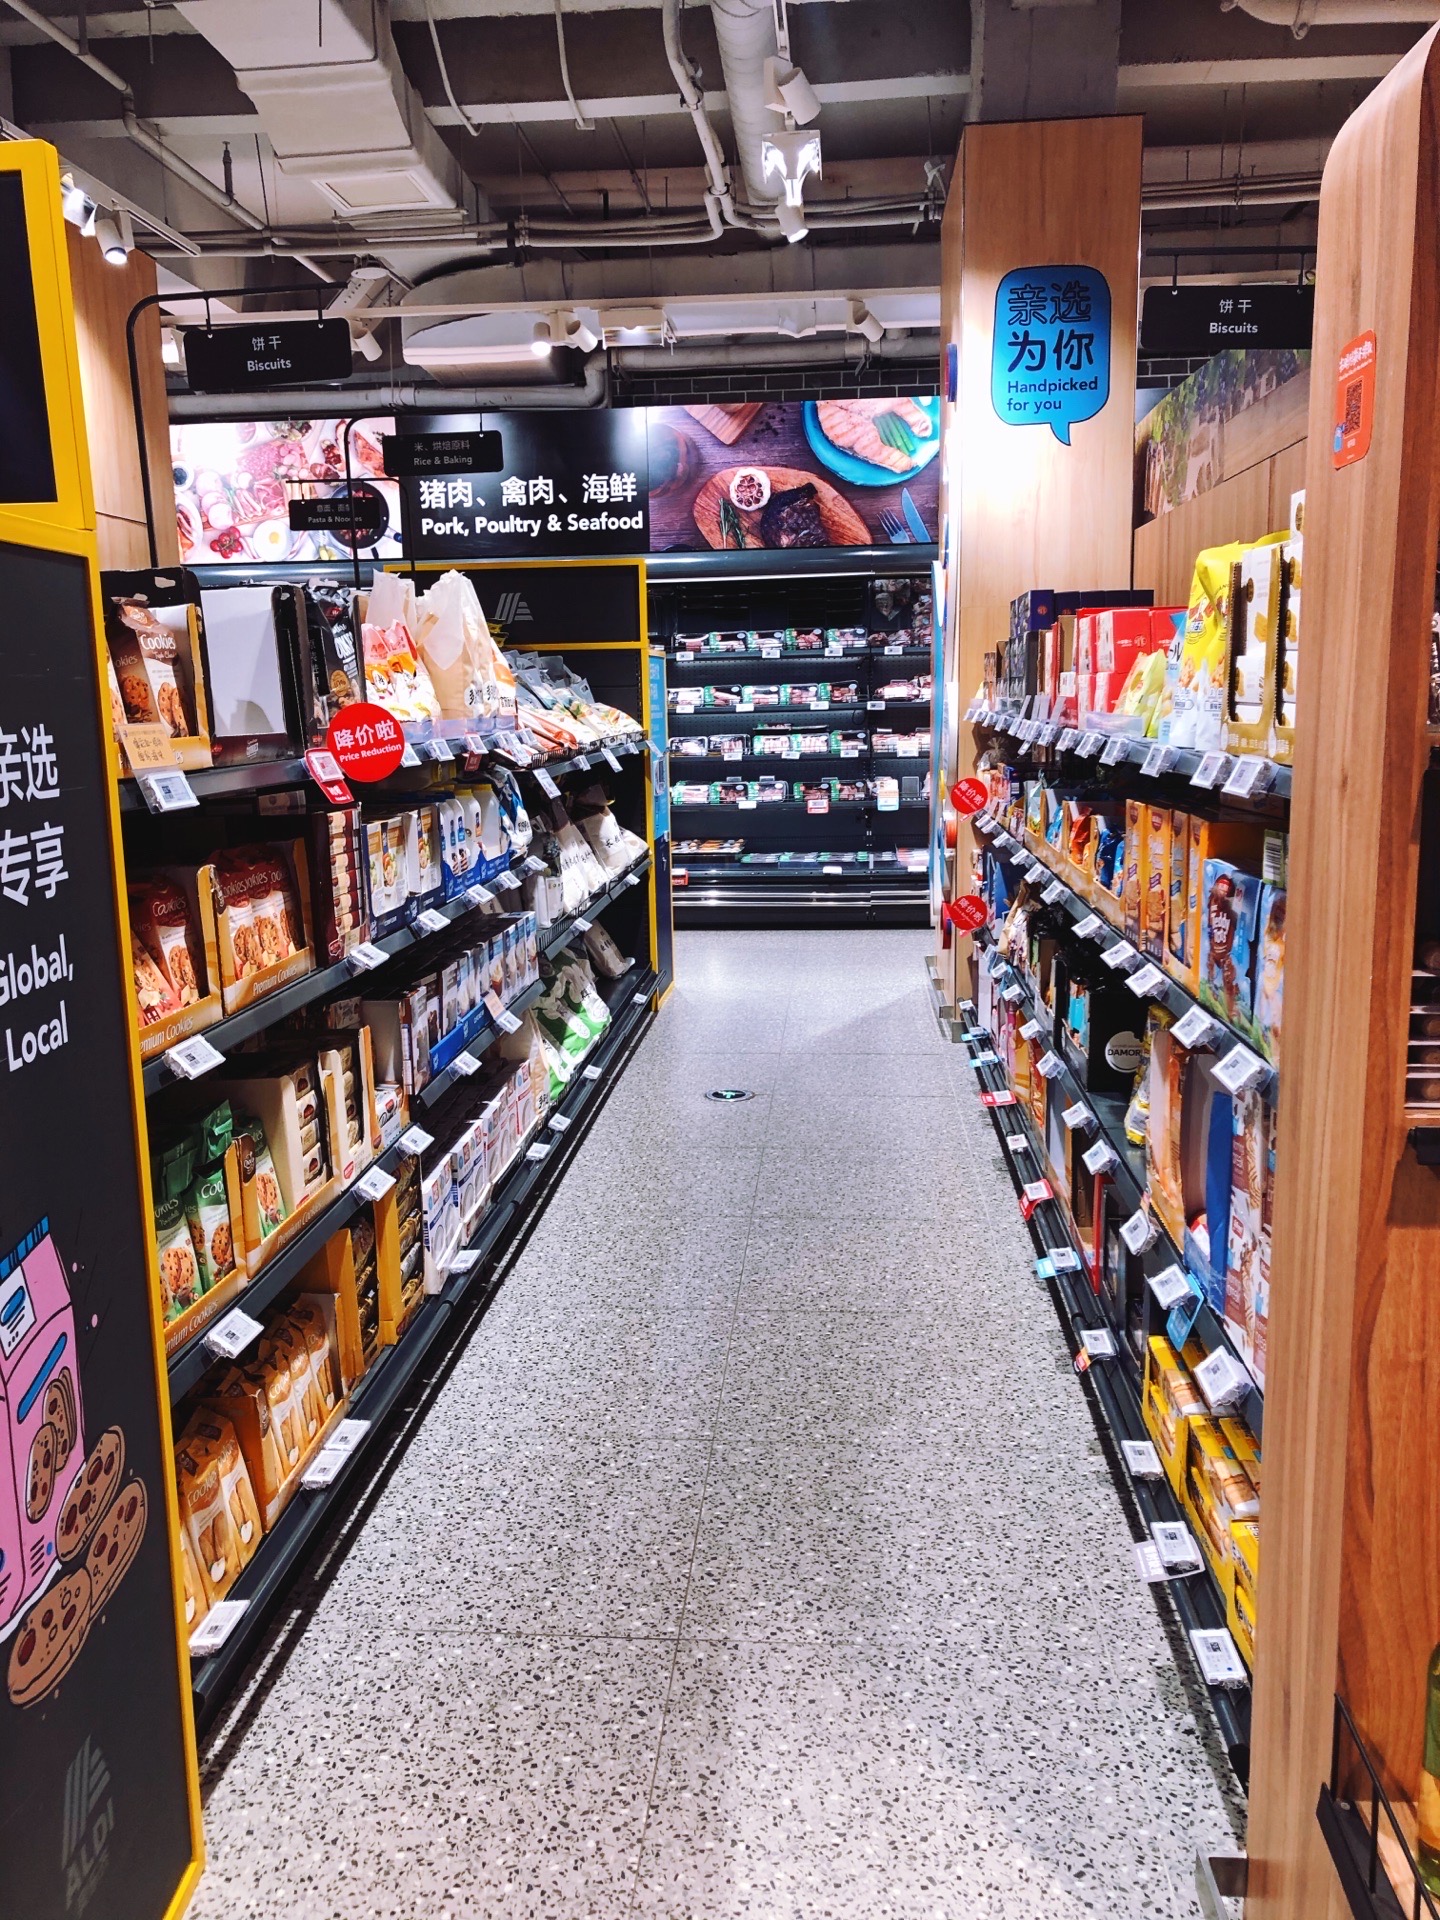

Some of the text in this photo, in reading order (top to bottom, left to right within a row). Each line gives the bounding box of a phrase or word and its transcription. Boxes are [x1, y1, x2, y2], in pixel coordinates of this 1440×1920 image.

[1008, 280, 1092, 326] 亲选
[1219, 299, 1252, 314] 饼干
[1209, 322, 1258, 333] Biscuits
[251, 335, 282, 351] 饼干
[1008, 329, 1094, 372] 为你
[247, 358, 292, 372] Biscuits
[1008, 376, 1098, 395] Handpicked
[1007, 398, 1062, 414] for you
[414, 455, 473, 466] Rice & Baking
[419, 472, 638, 509] 猪肉、禽肉、海鲜
[308, 516, 326, 524] Pasta
[421, 511, 643, 537] Pork, Poultry & Seafood
[140, 633, 176, 650] Cookies
[333, 719, 397, 751] 降价啦
[339, 743, 402, 763] Price Reduction
[253, 965, 297, 997] Premium Cookies
[6, 1000, 69, 1072] Local
[140, 1015, 193, 1052] emium Cookies
[66, 1796, 114, 1910] ALDI
